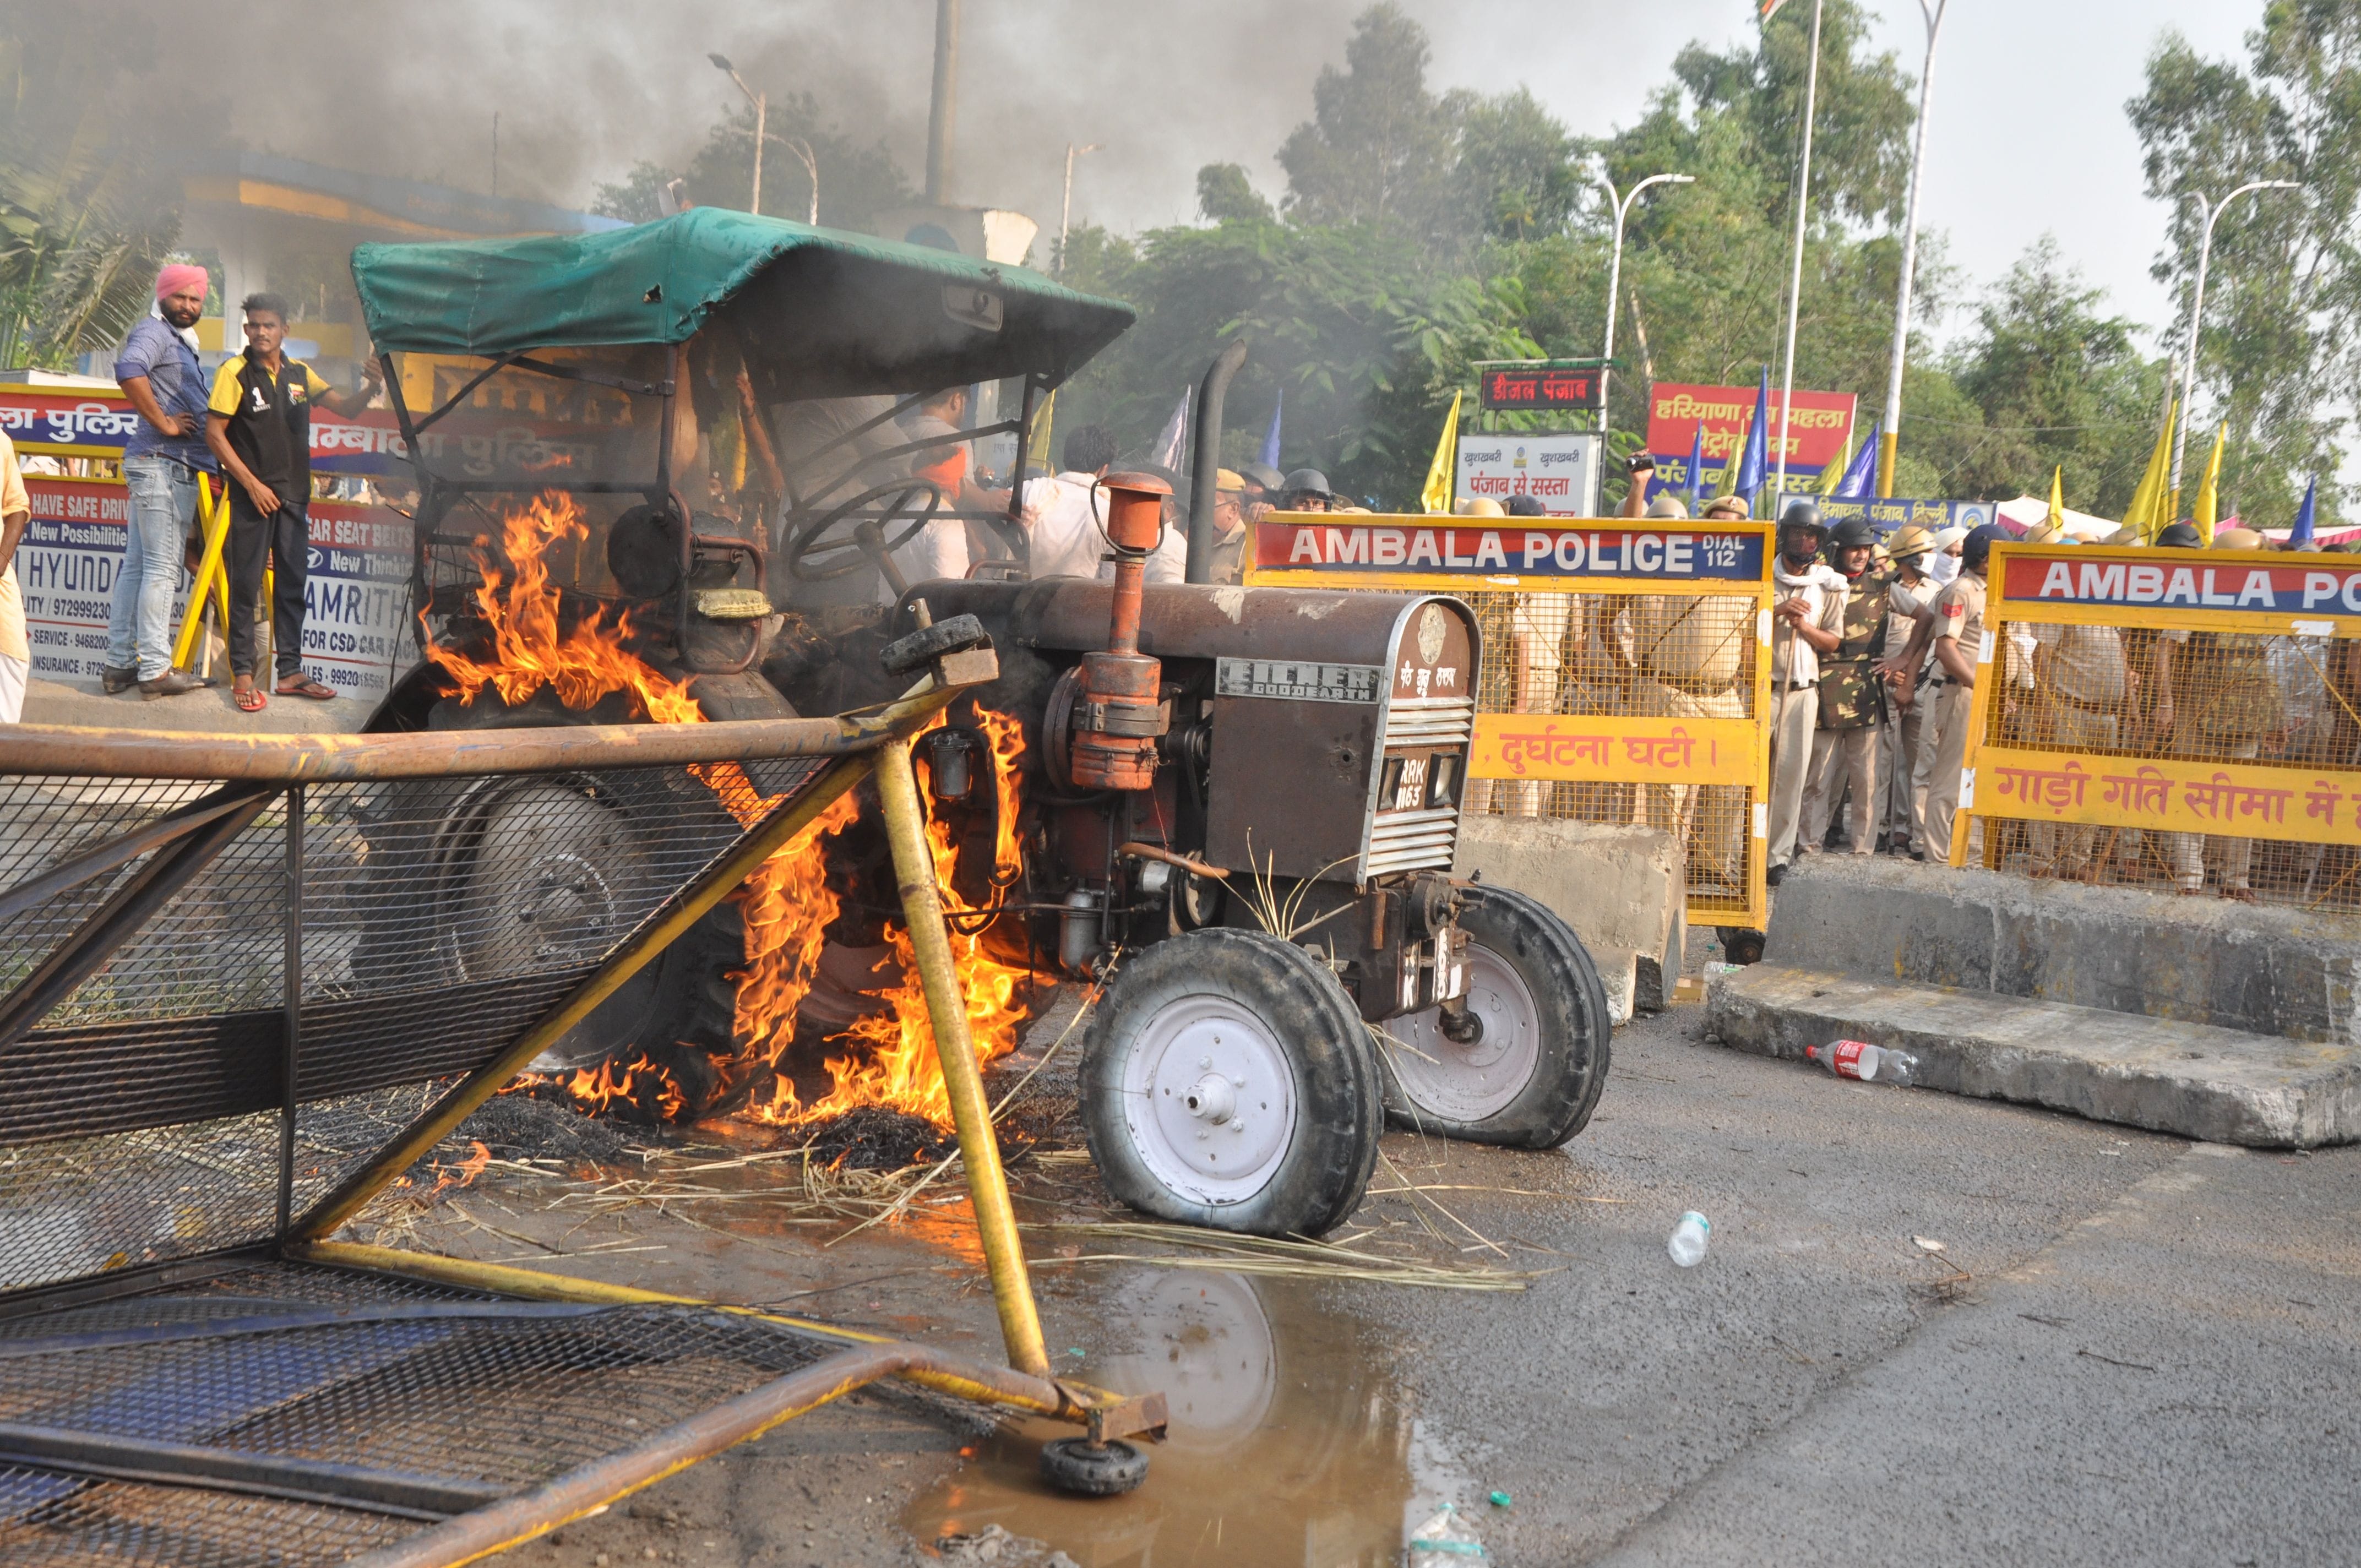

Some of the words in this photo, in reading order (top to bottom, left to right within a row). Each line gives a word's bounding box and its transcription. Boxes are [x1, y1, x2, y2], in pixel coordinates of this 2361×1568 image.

[252, 386, 265, 406] 1
[1543, 373, 1588, 400] पंजाब
[1656, 394, 1742, 421] हरियाणा
[1470, 470, 1510, 494] पंजाब
[1514, 470, 1527, 495] से
[1531, 478, 1570, 495] सस्ता
[32, 493, 64, 516] HAVE
[67, 495, 97, 519] SAFE
[101, 498, 129, 520] DRIV
[31, 521, 57, 542] New
[61, 524, 127, 547] Possibilitie
[334, 520, 369, 546] SEAT
[1702, 534, 1745, 551] DIAL
[331, 550, 360, 573] New
[1289, 529, 1508, 568] AMBALA
[1524, 532, 1693, 573] POLICE
[1706, 551, 1736, 567] 112
[2039, 562, 2276, 607] AMBALA
[34, 629, 68, 646] SERVICE
[302, 629, 326, 650] FOR
[330, 631, 357, 652] CSD
[32, 655, 79, 674] INSURANCE
[1252, 683, 1370, 700] GOODEARTH
[1499, 724, 1614, 775] दुर्घटना
[1623, 726, 1696, 768] घटी
[1994, 760, 2091, 815] गाड़ी
[2102, 765, 2175, 815] गति
[2184, 772, 2294, 824] सीमा
[2305, 780, 2343, 827] में
